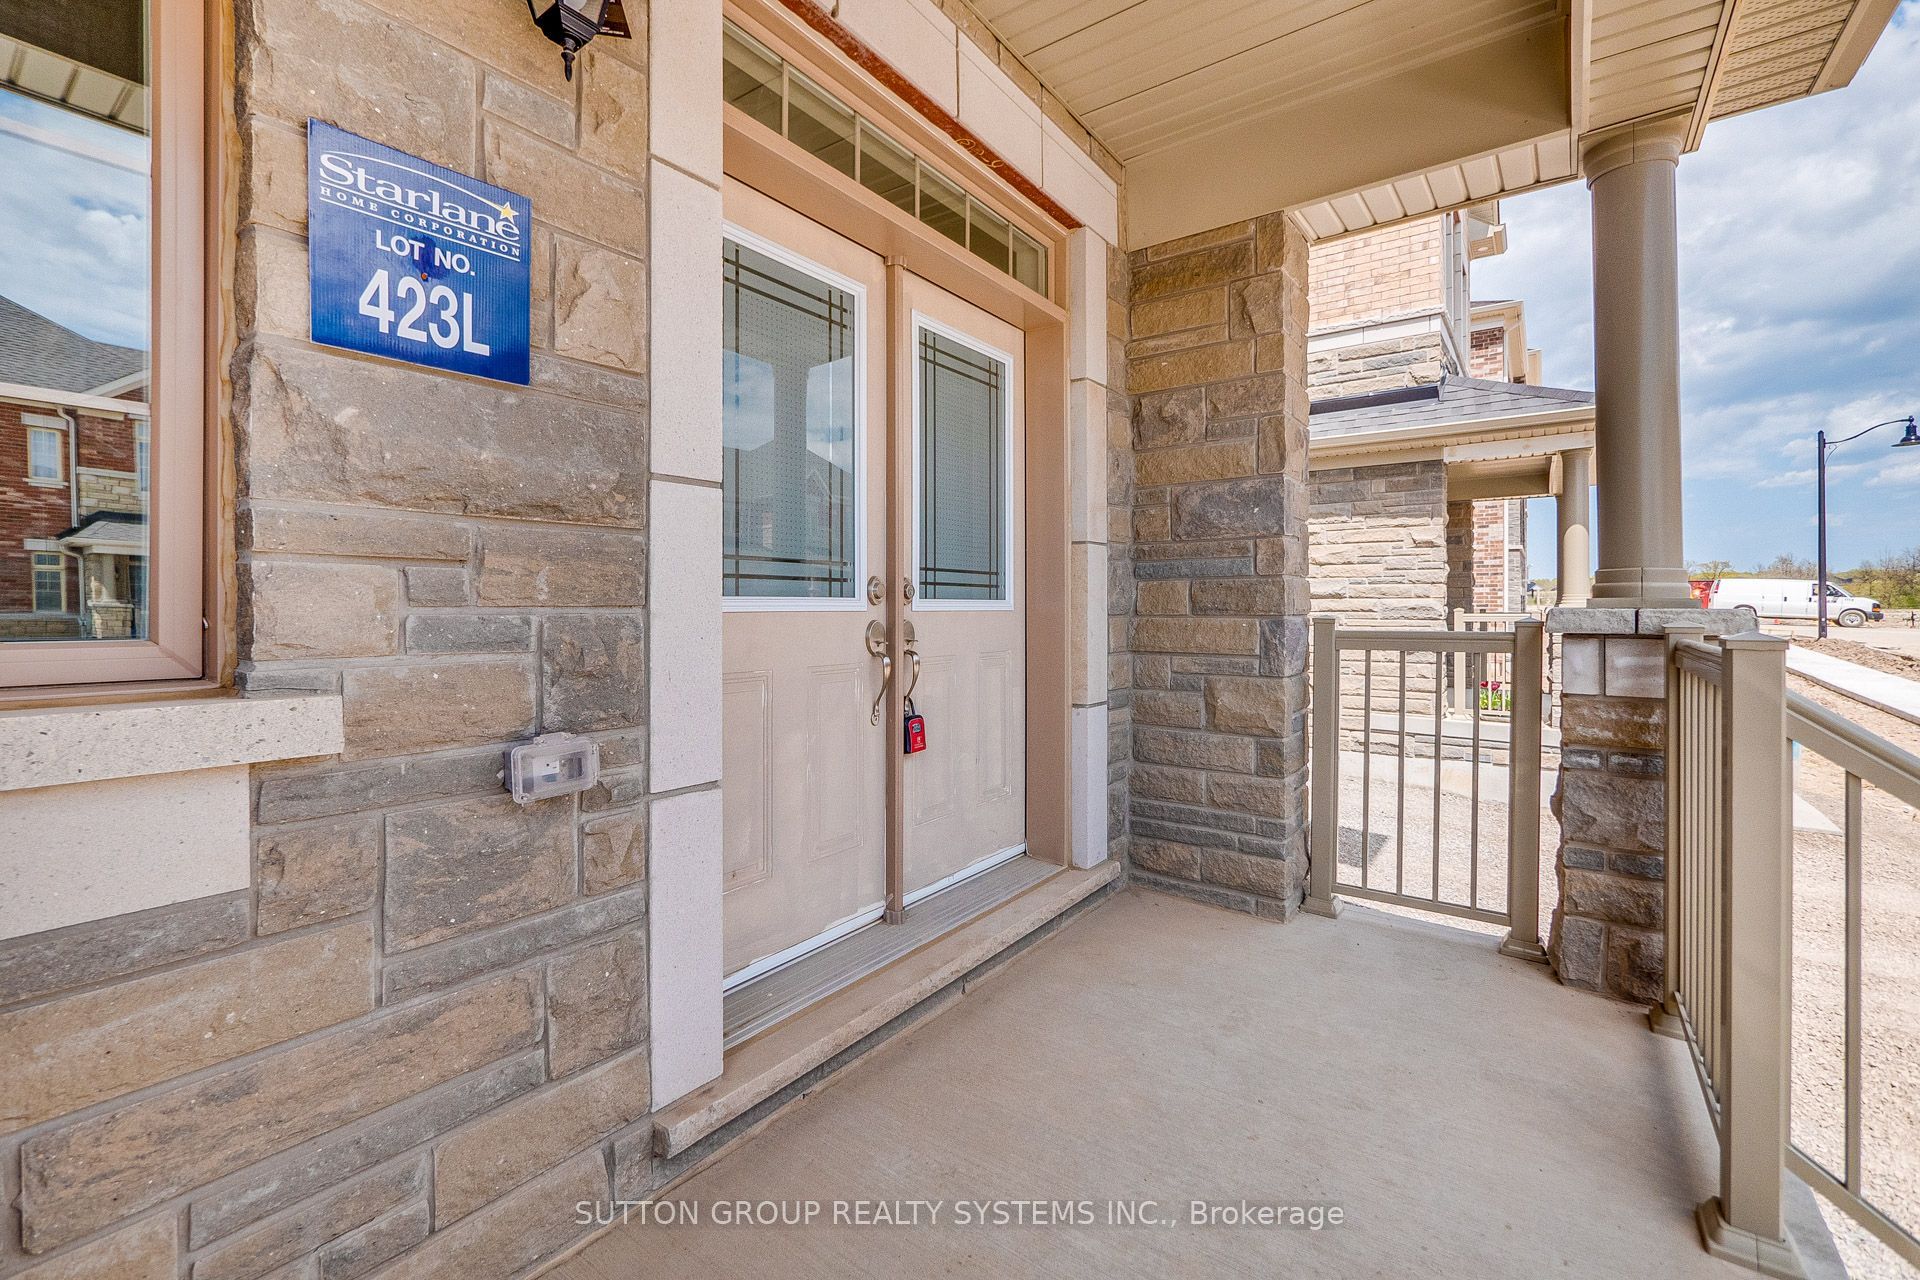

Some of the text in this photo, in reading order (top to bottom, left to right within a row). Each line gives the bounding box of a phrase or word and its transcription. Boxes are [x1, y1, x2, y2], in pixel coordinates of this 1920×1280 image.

[319, 153, 520, 241] Starlane
[320, 185, 520, 257] HOME CORPORATION
[375, 229, 476, 277] LOT NO.
[358, 268, 491, 357] 423L
